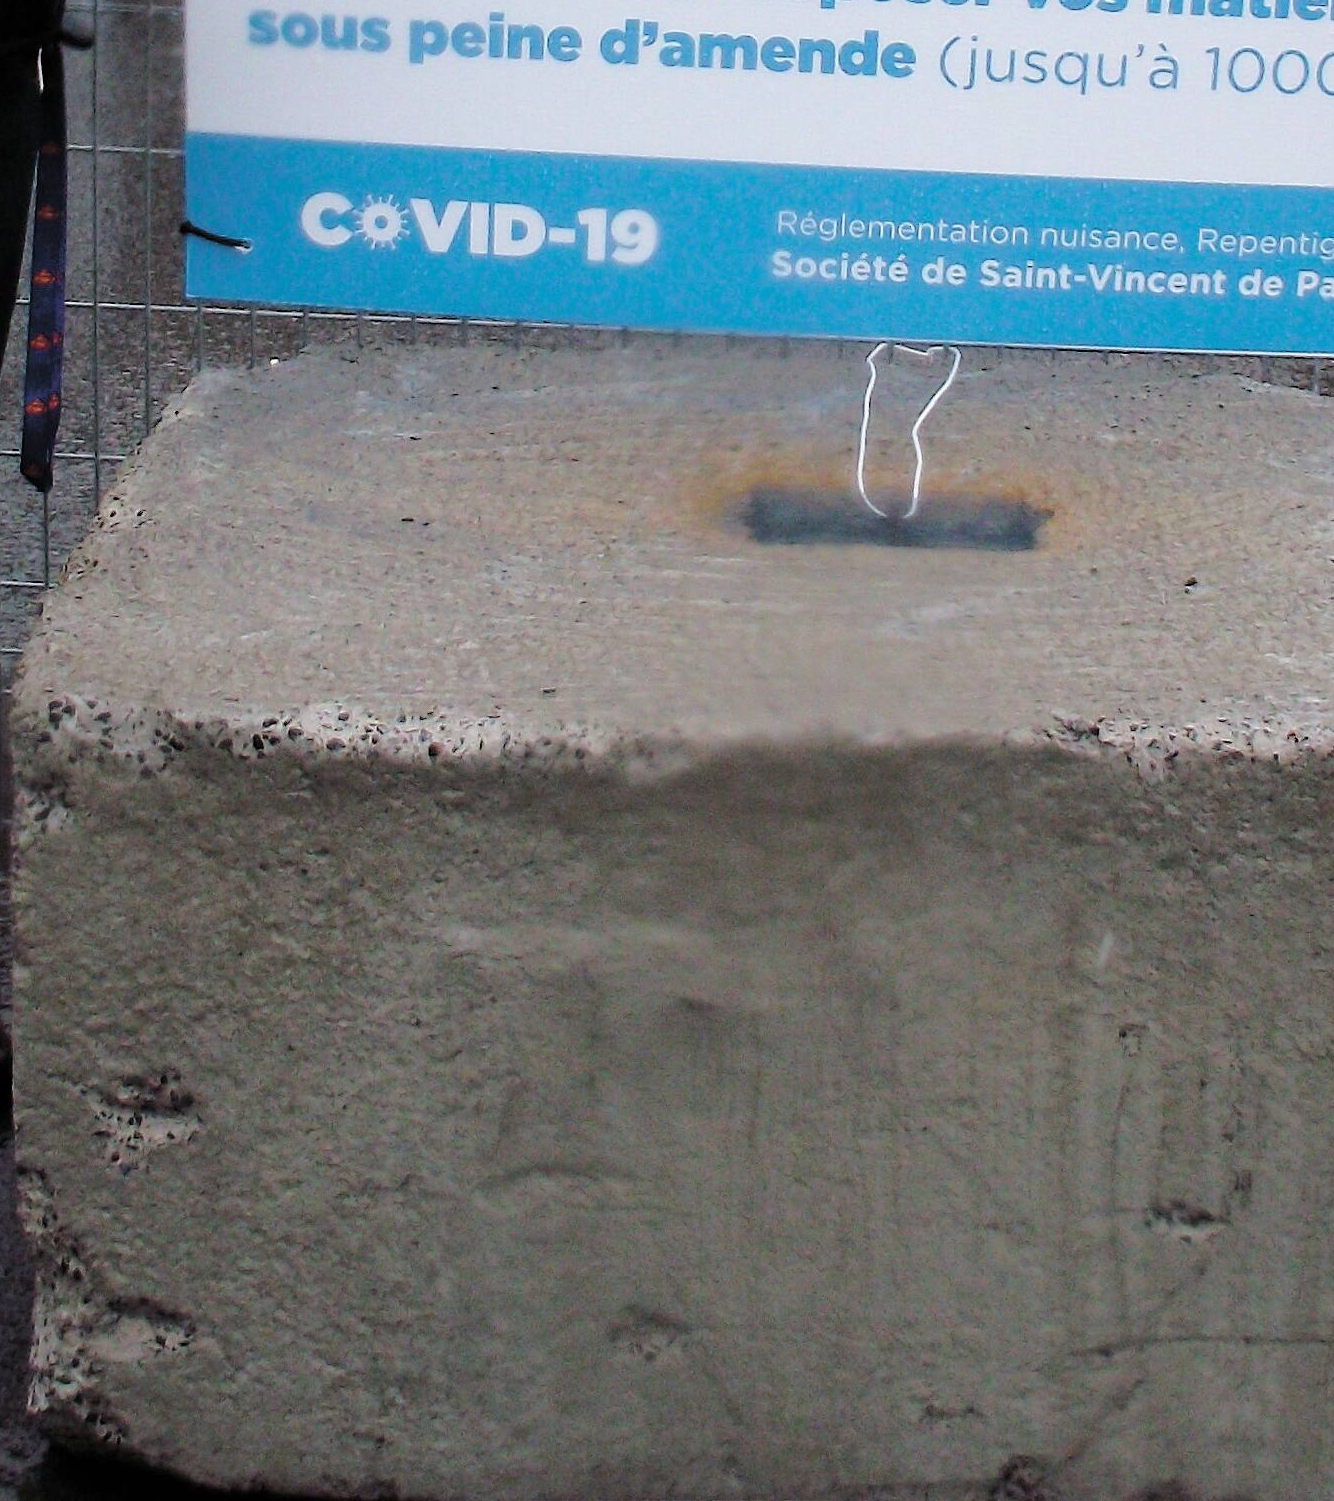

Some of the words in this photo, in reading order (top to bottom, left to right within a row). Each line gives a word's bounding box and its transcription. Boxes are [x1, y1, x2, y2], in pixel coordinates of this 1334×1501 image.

[248, 10, 390, 52] sous
[409, 12, 581, 64] peine
[600, 19, 916, 78] d’amende
[940, 36, 1179, 95] (jusqu’à
[778, 209, 1029, 246] Réglementation
[1041, 228, 1185, 254] nuisance,
[772, 250, 908, 282] Société
[922, 257, 966, 286] de
[980, 260, 1227, 296] Saint-Vincent
[1239, 269, 1284, 298] de
